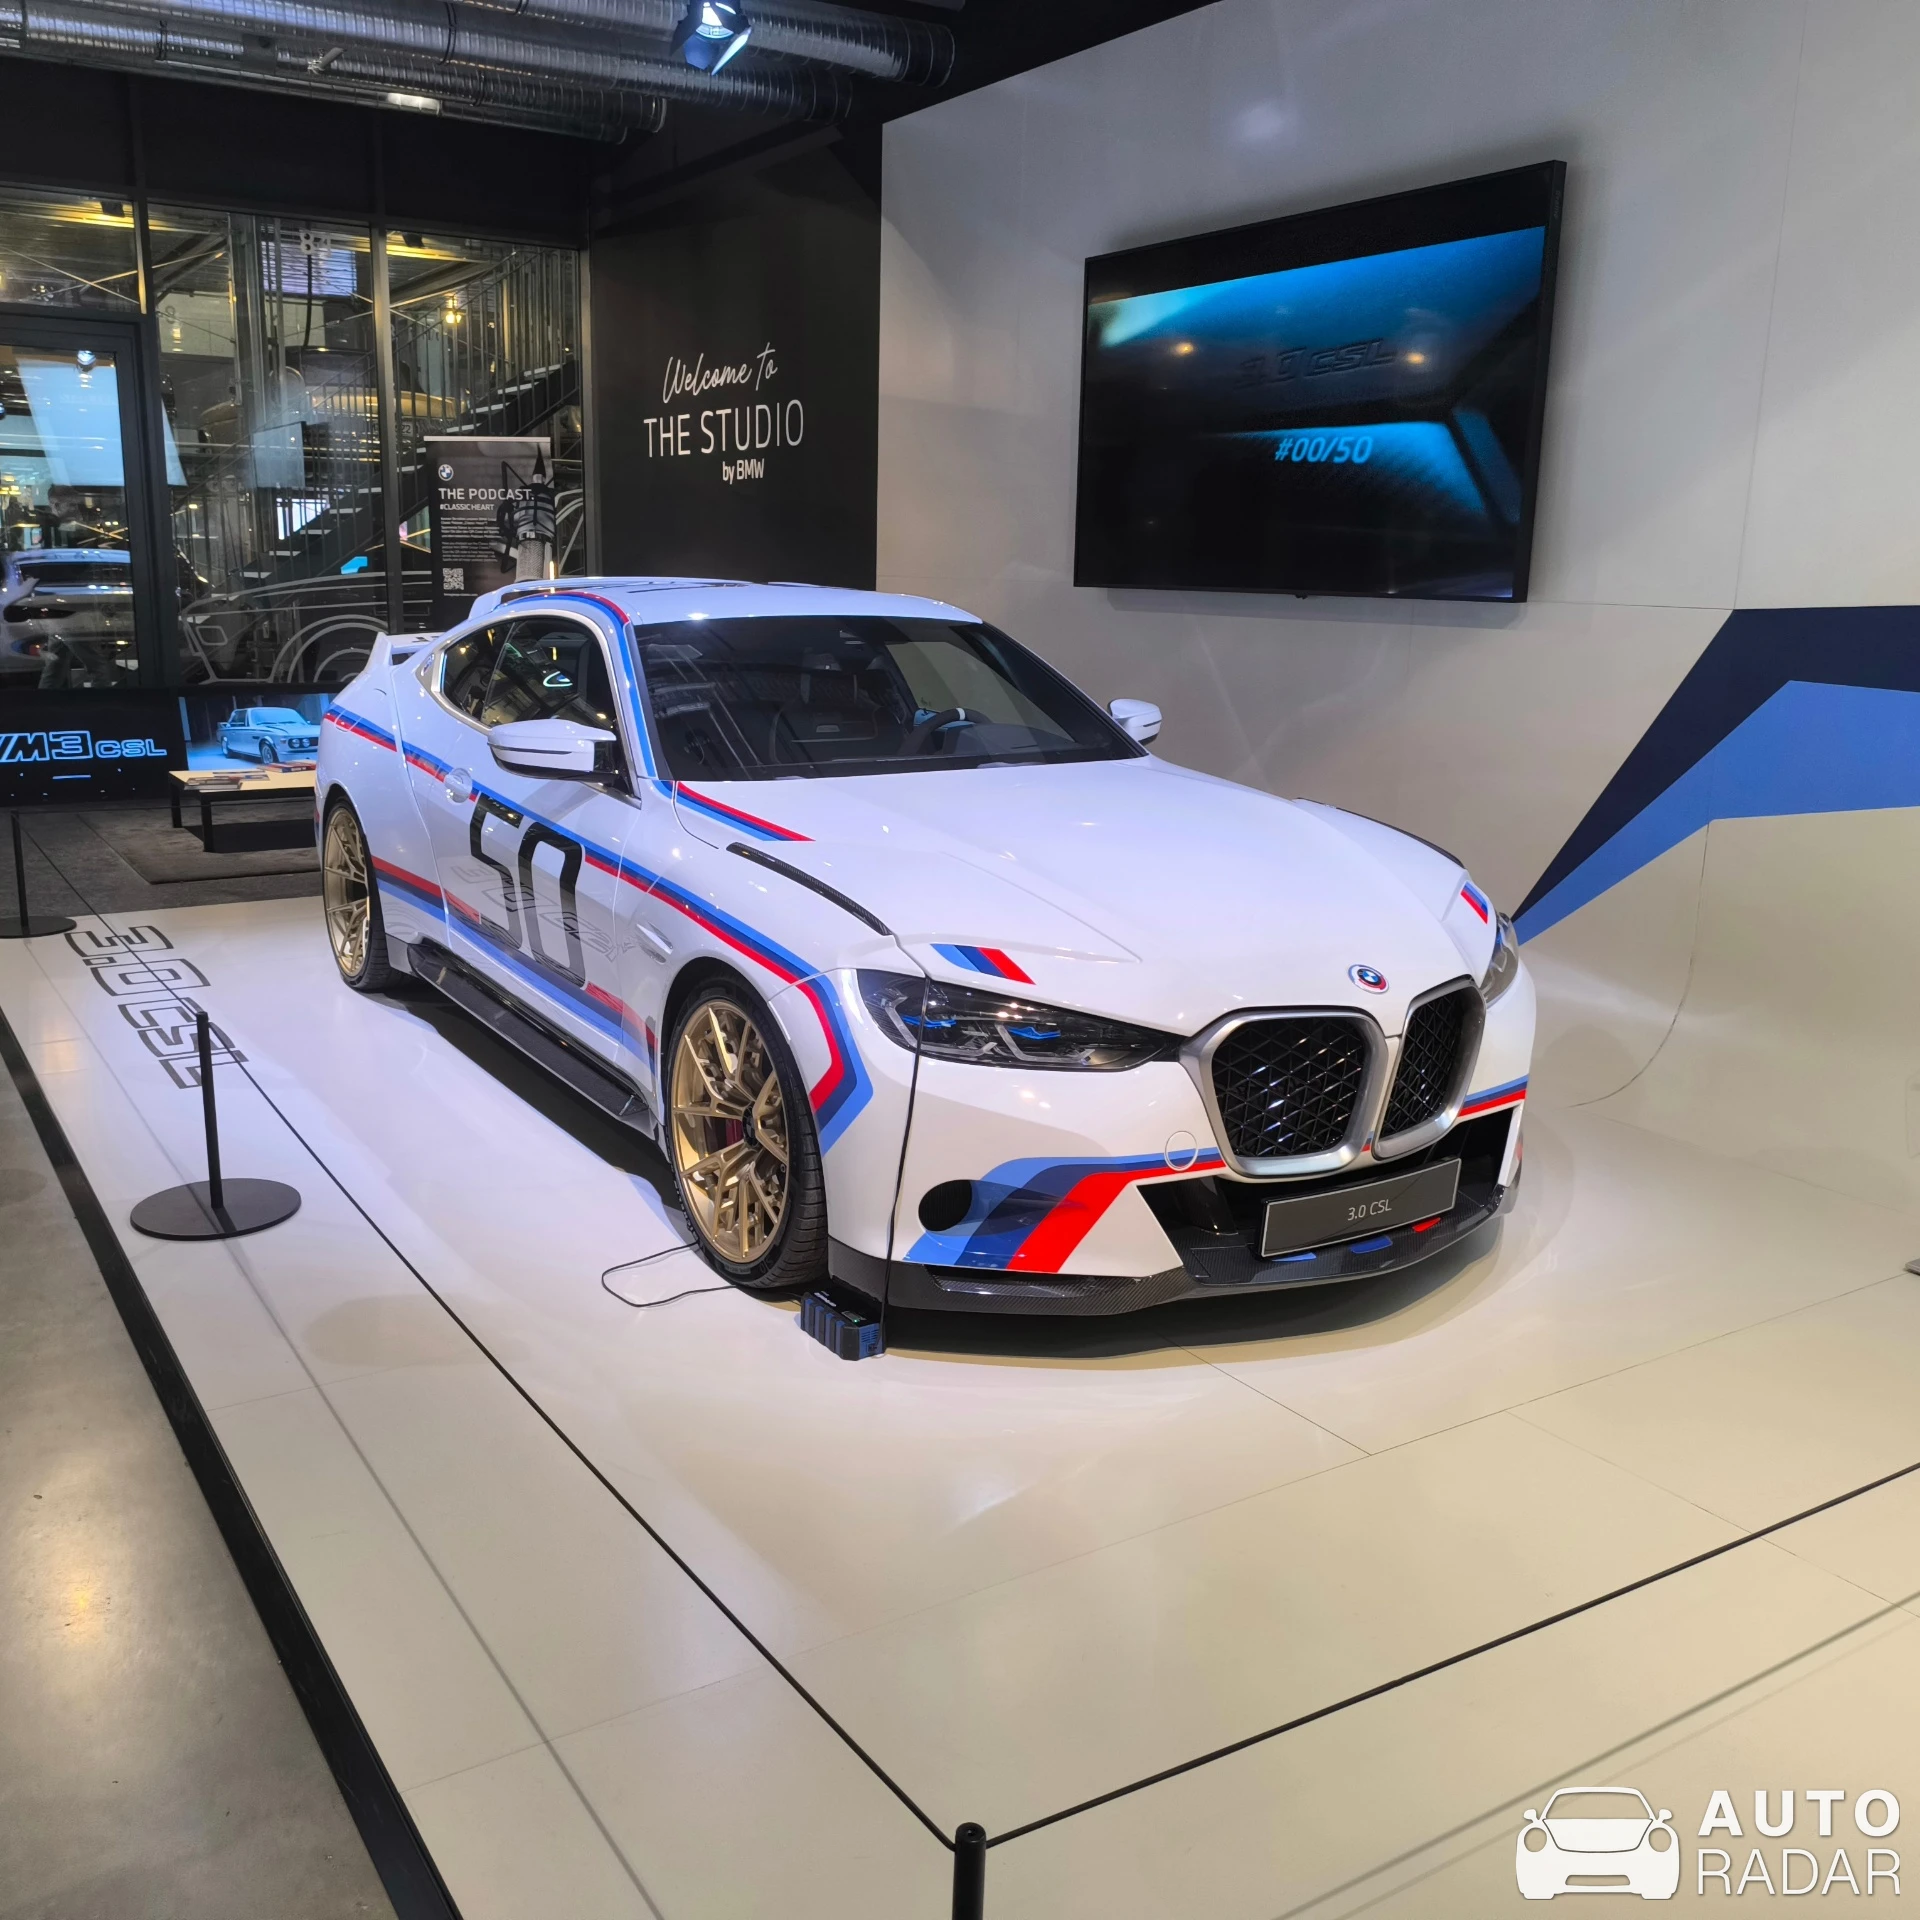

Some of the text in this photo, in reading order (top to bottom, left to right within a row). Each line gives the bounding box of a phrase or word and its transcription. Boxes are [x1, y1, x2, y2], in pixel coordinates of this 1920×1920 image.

[662, 352, 752, 404] Welcome
[643, 399, 804, 458] THE STUDIO
[1274, 436, 1373, 464] #00/50
[722, 458, 765, 485] by BMW
[438, 488, 535, 501] THE PODCAST.
[94, 738, 168, 759] CSL
[469, 791, 587, 991] 50
[64, 925, 211, 997] 3.0
[1347, 1198, 1393, 1221] 3.0 CSL
